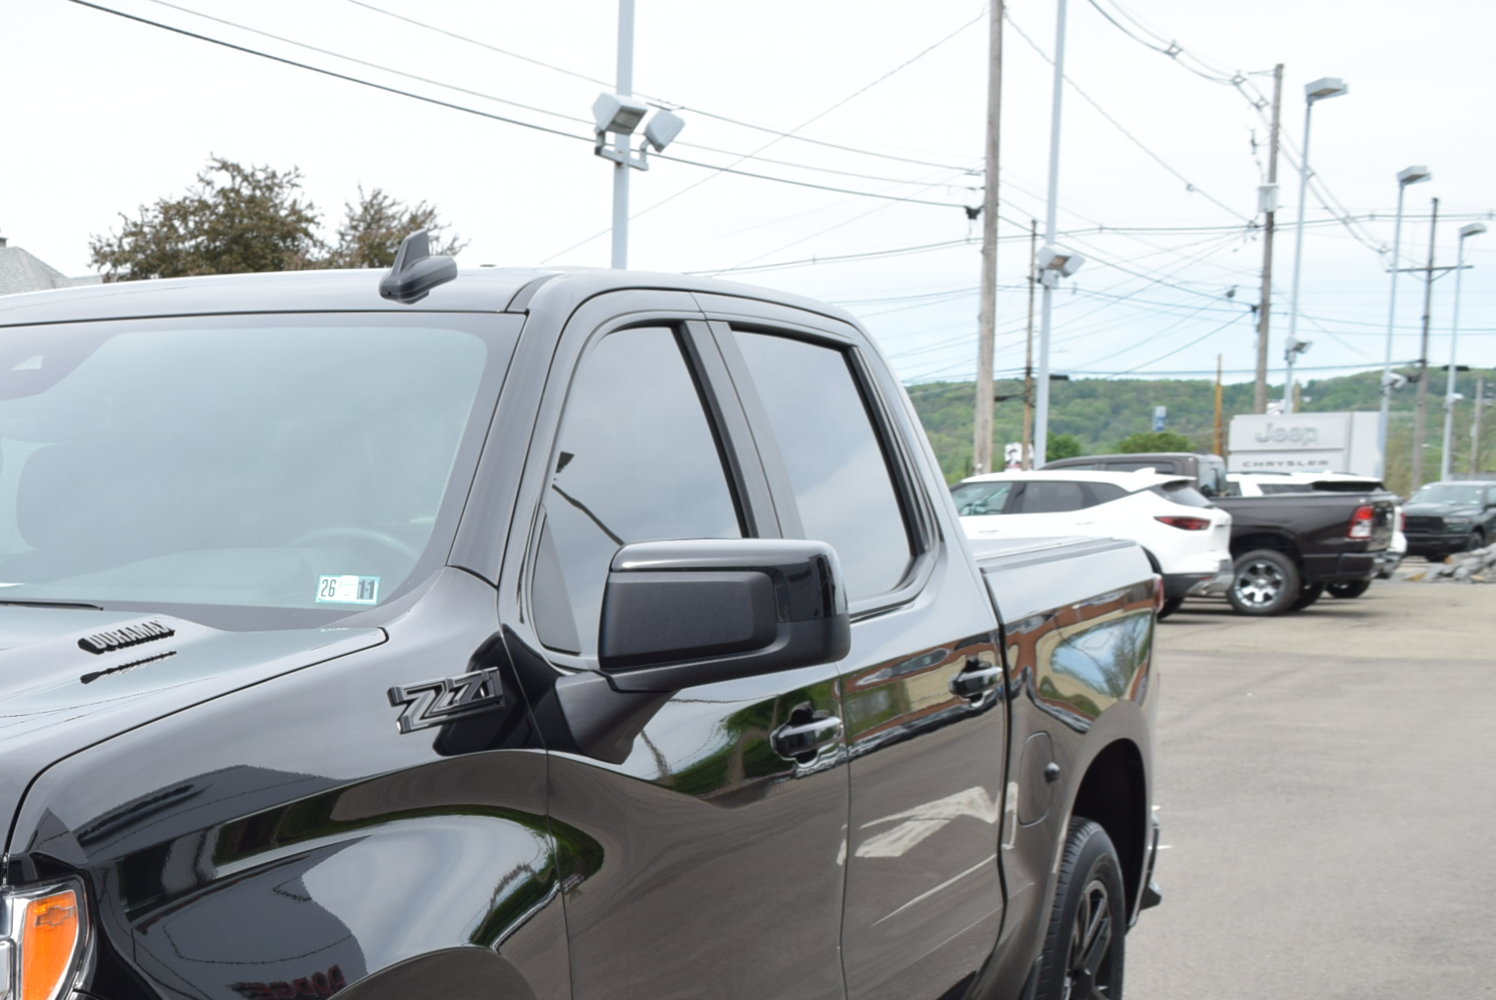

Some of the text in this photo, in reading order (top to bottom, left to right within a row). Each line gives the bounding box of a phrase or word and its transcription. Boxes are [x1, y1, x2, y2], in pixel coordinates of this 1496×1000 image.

[1256, 423, 1318, 445] Jeep
[320, 578, 376, 601] 26 11
[387, 667, 504, 734] Z71
